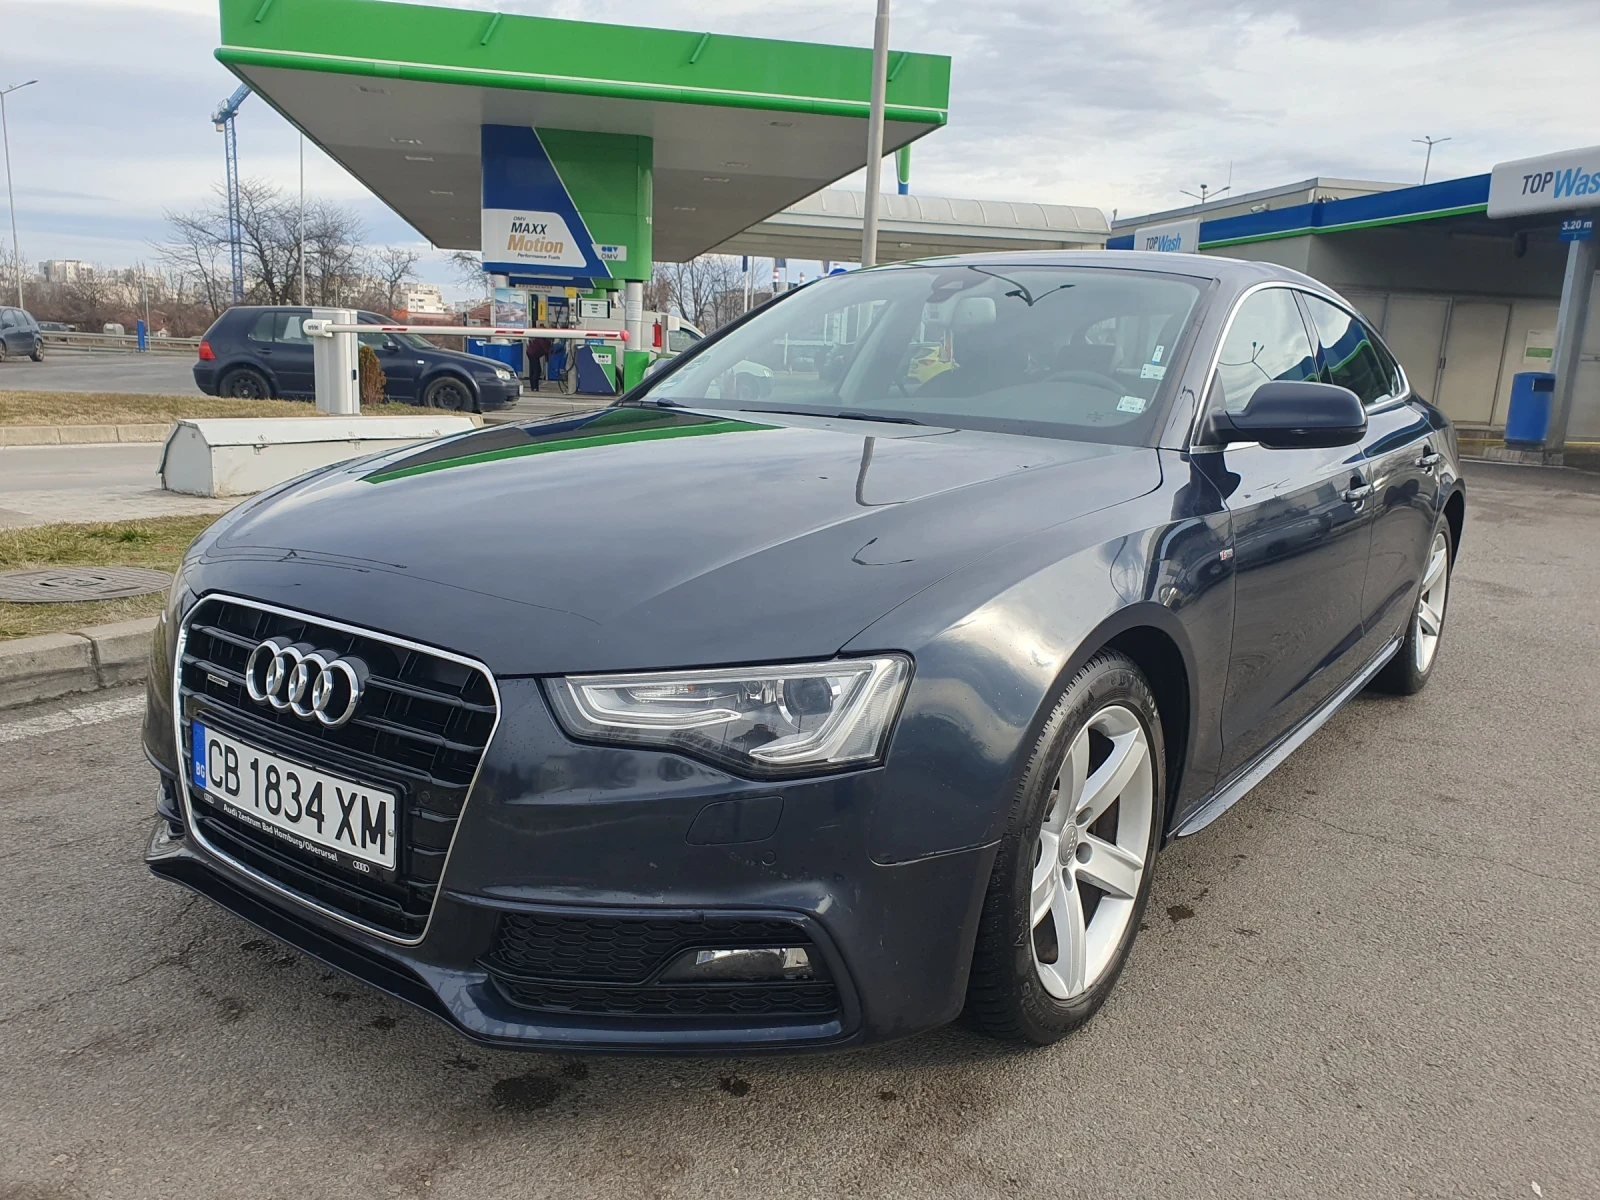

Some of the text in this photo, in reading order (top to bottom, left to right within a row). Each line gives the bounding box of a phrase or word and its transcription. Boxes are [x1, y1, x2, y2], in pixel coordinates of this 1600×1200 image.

[511, 222, 547, 235] MAXX
[1562, 220, 1582, 230] 3.20
[507, 234, 564, 253] Motion
[517, 252, 547, 260] Performance
[195, 761, 205, 778] BG
[208, 739, 386, 855] CB 1834 XM
[223, 803, 338, 861] Audi Zentrum Bad Homburg/Oberursel
